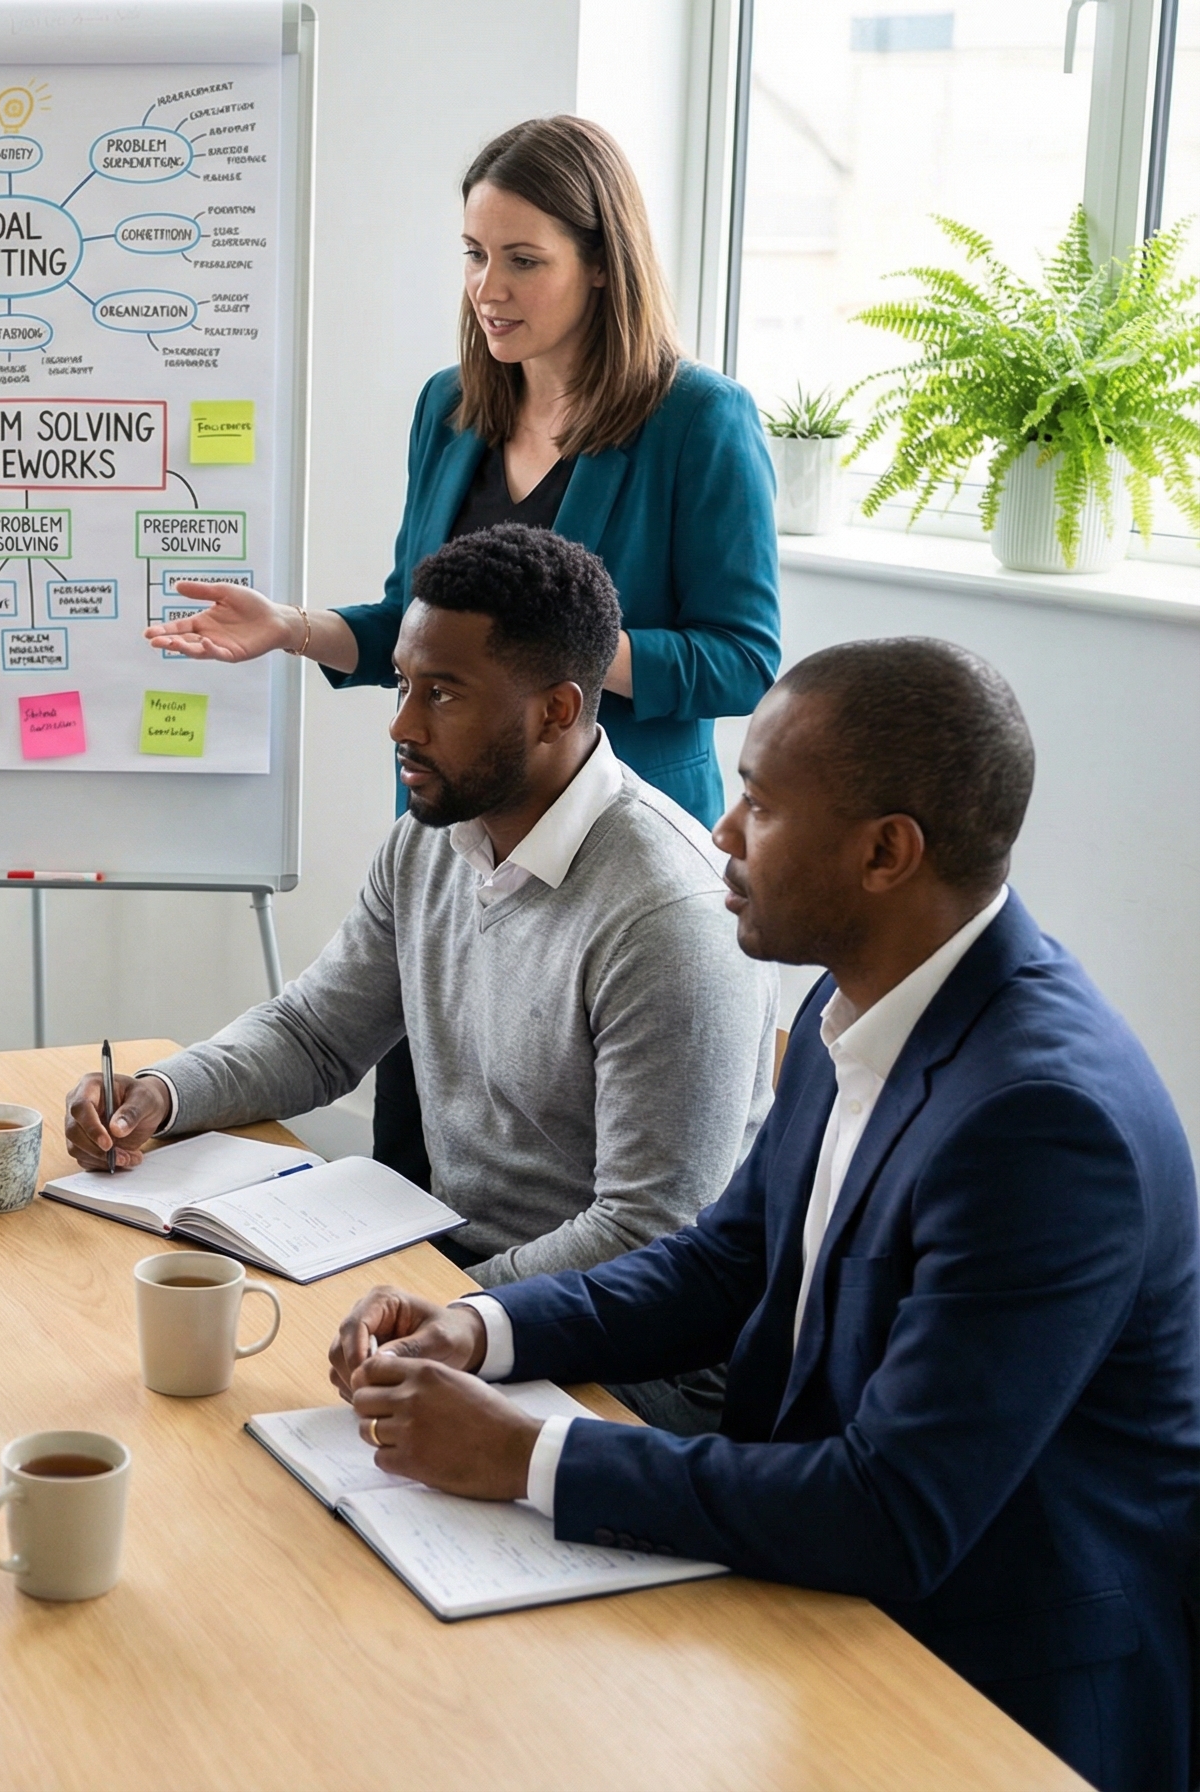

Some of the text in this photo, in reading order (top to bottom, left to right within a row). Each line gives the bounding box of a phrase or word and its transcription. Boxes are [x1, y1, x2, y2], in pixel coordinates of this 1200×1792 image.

[107, 139, 166, 153] PROBLEM
[37, 410, 155, 442] SOLVING
[162, 537, 221, 552] SOLVING
